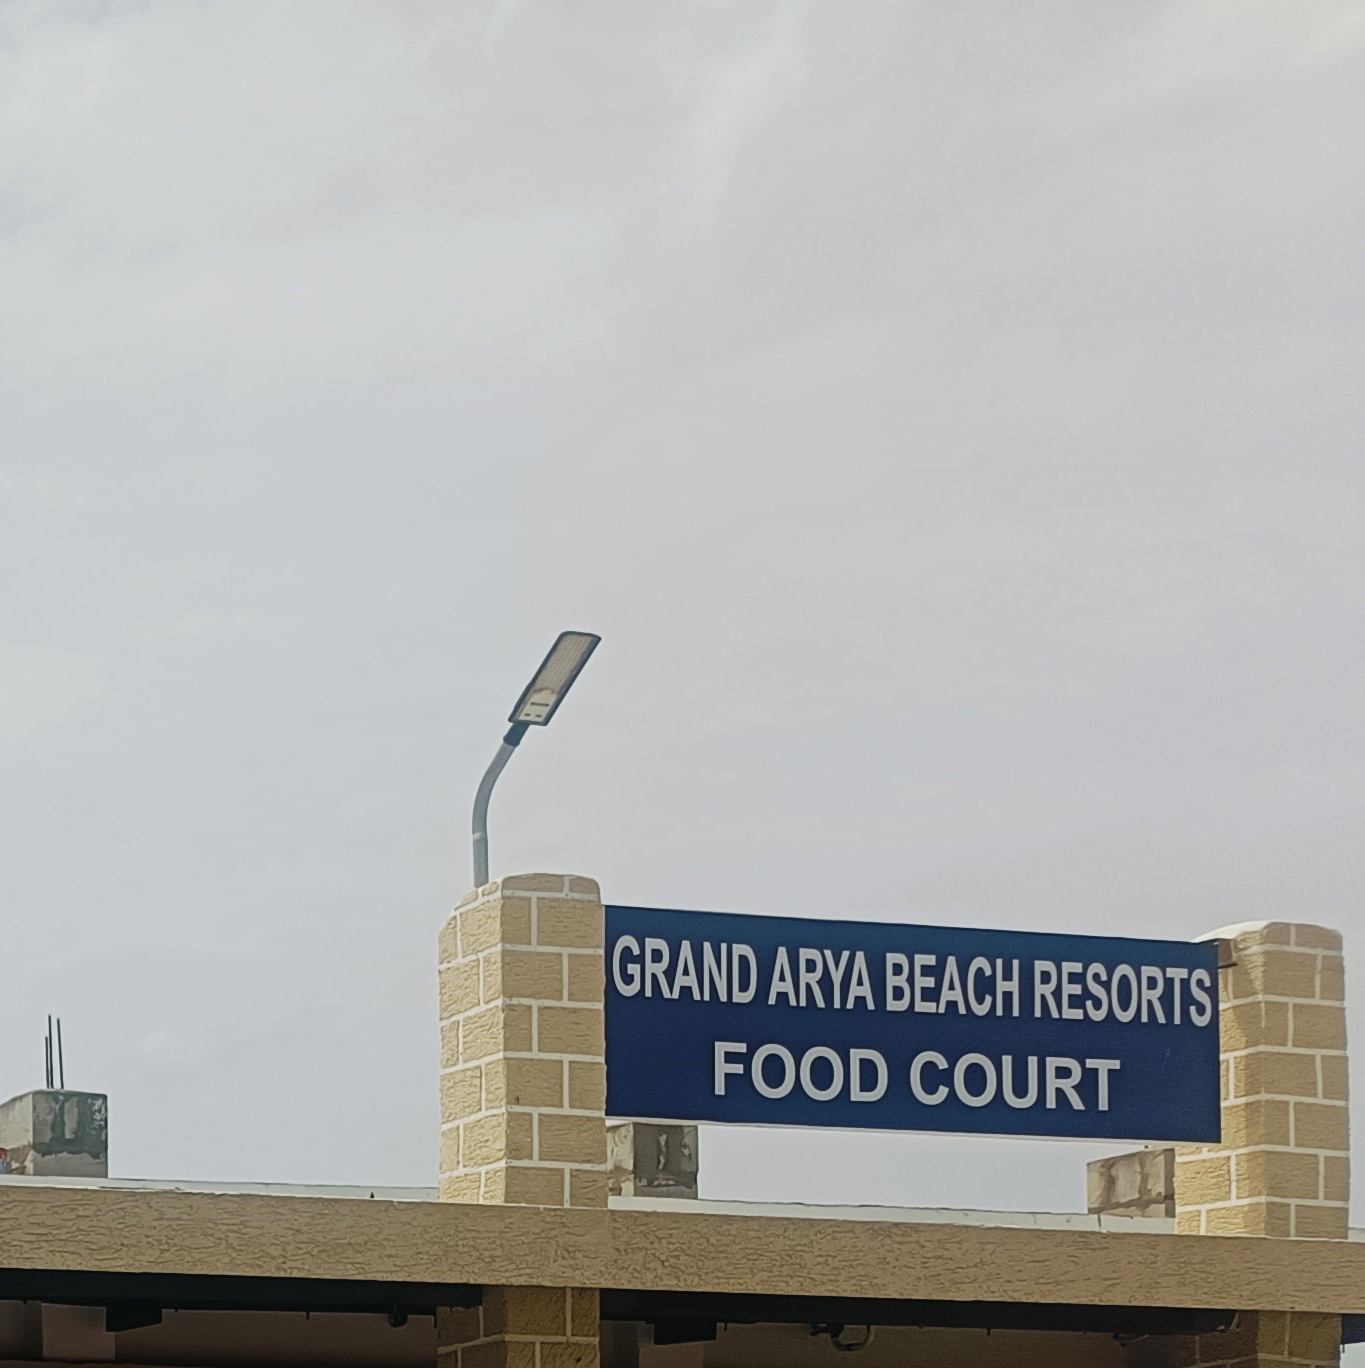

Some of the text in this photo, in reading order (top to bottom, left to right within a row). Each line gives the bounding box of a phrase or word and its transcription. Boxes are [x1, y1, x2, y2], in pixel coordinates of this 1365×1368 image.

[613, 935, 1211, 1026] GRAND ARYA BEACH RESORTS
[715, 1042, 1120, 1110] FOOD COURT
